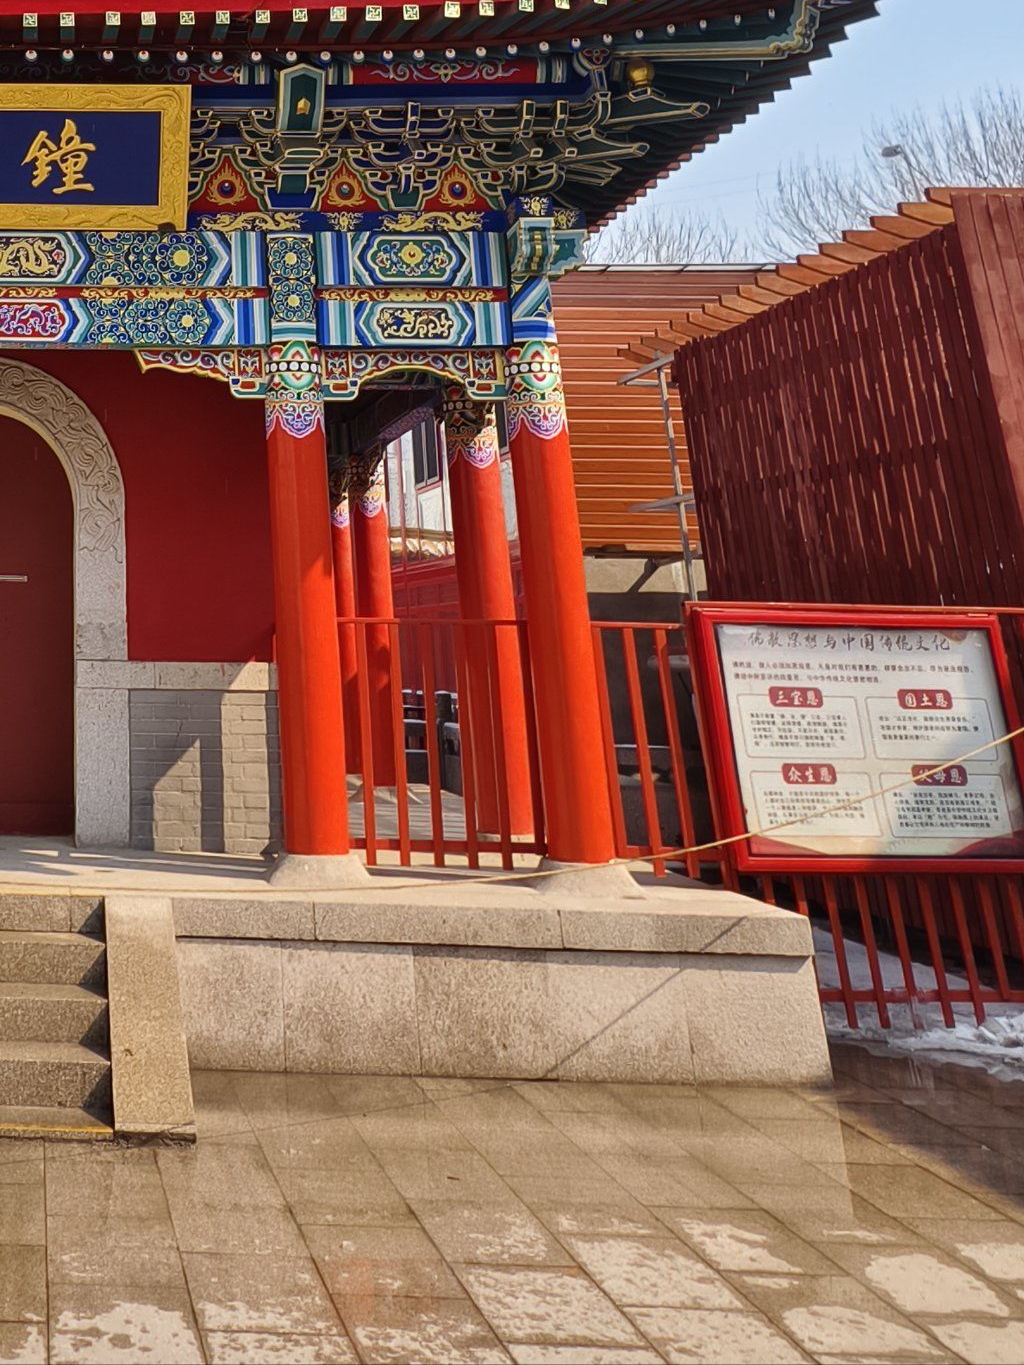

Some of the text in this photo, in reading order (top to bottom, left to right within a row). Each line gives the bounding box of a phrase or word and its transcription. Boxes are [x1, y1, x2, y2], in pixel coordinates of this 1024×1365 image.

[775, 689, 819, 706] 三宝恩
[904, 692, 948, 708] 国土恩
[787, 765, 833, 783] 众生恩
